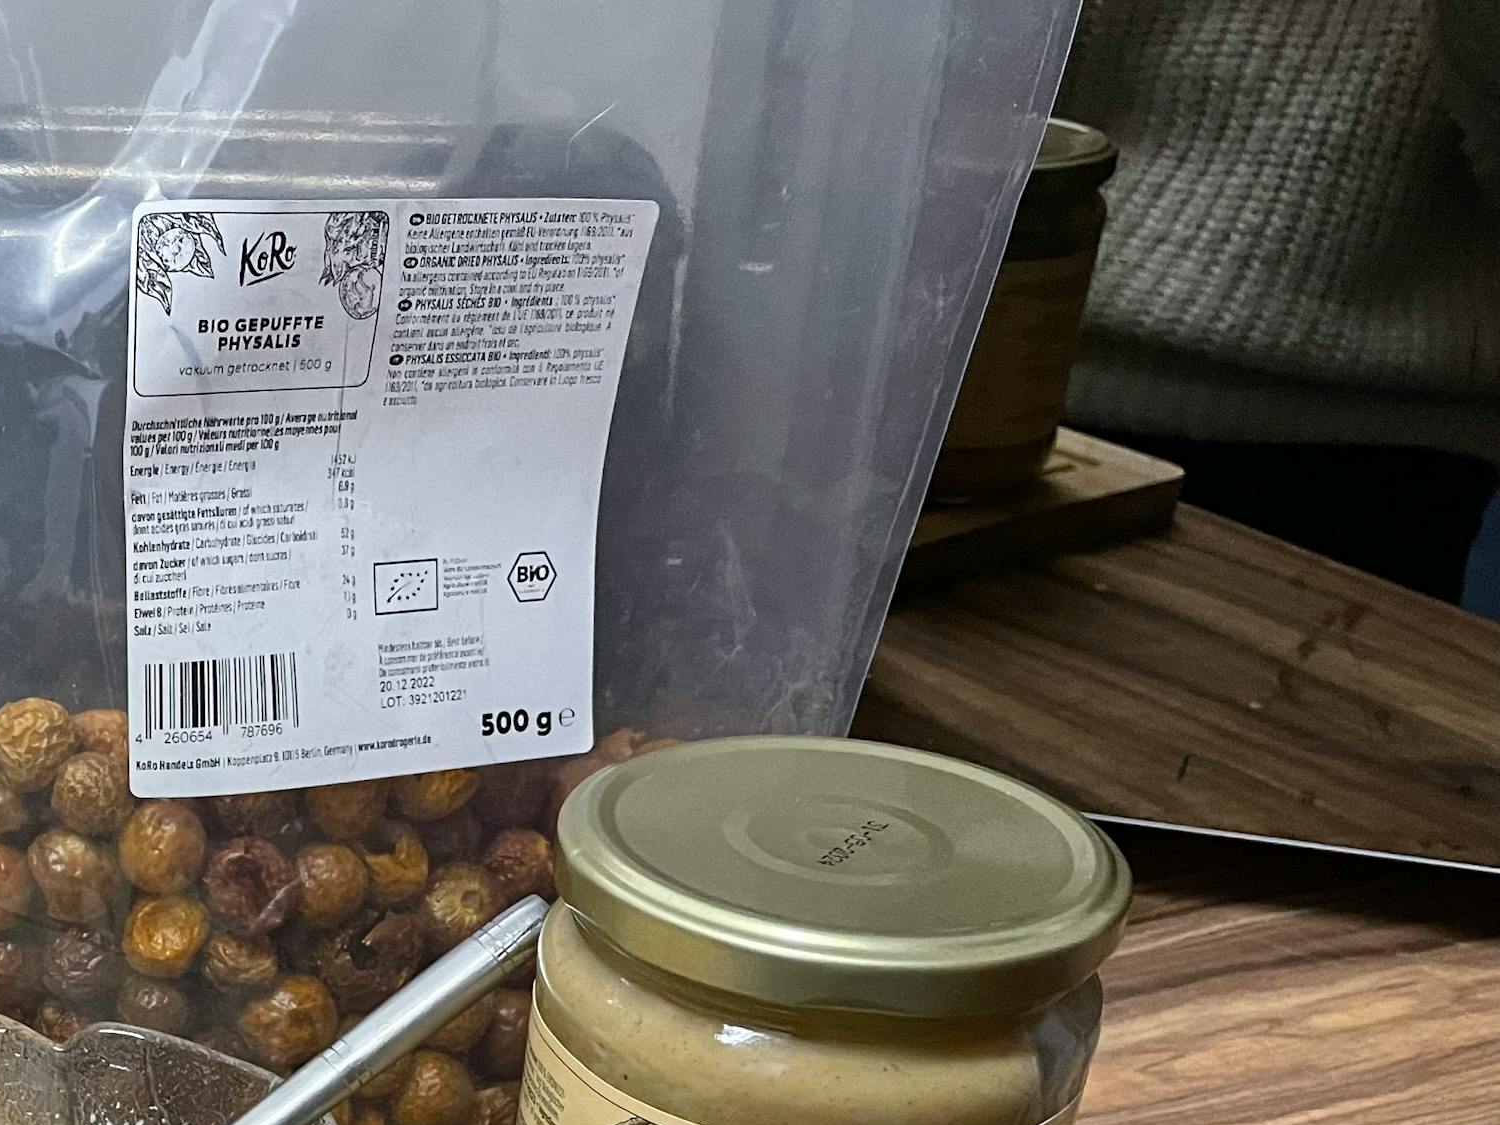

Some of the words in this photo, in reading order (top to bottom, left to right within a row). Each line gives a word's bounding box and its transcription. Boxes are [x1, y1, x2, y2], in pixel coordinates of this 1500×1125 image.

[441, 213, 498, 224] GETROCKNETE
[500, 212, 537, 223] PHYSALIS
[239, 232, 297, 287] KoRo
[420, 256, 456, 268] ORGANIC
[457, 255, 480, 267] DRIED
[482, 254, 518, 267] PHYSALIS
[415, 299, 453, 310] PHYSALIS
[198, 319, 229, 333] BIO
[235, 316, 324, 332] GEPUFFTE
[218, 334, 301, 351] PHYSALIS
[406, 354, 444, 365] PHYSALIS
[179, 363, 224, 376] vakuum
[227, 360, 290, 375] getrocknet
[325, 360, 332, 371] g
[482, 709, 529, 736] 500
[537, 711, 552, 735] g
[135, 733, 143, 744] 4
[164, 731, 212, 744] 260654
[241, 723, 283, 737] 787696
